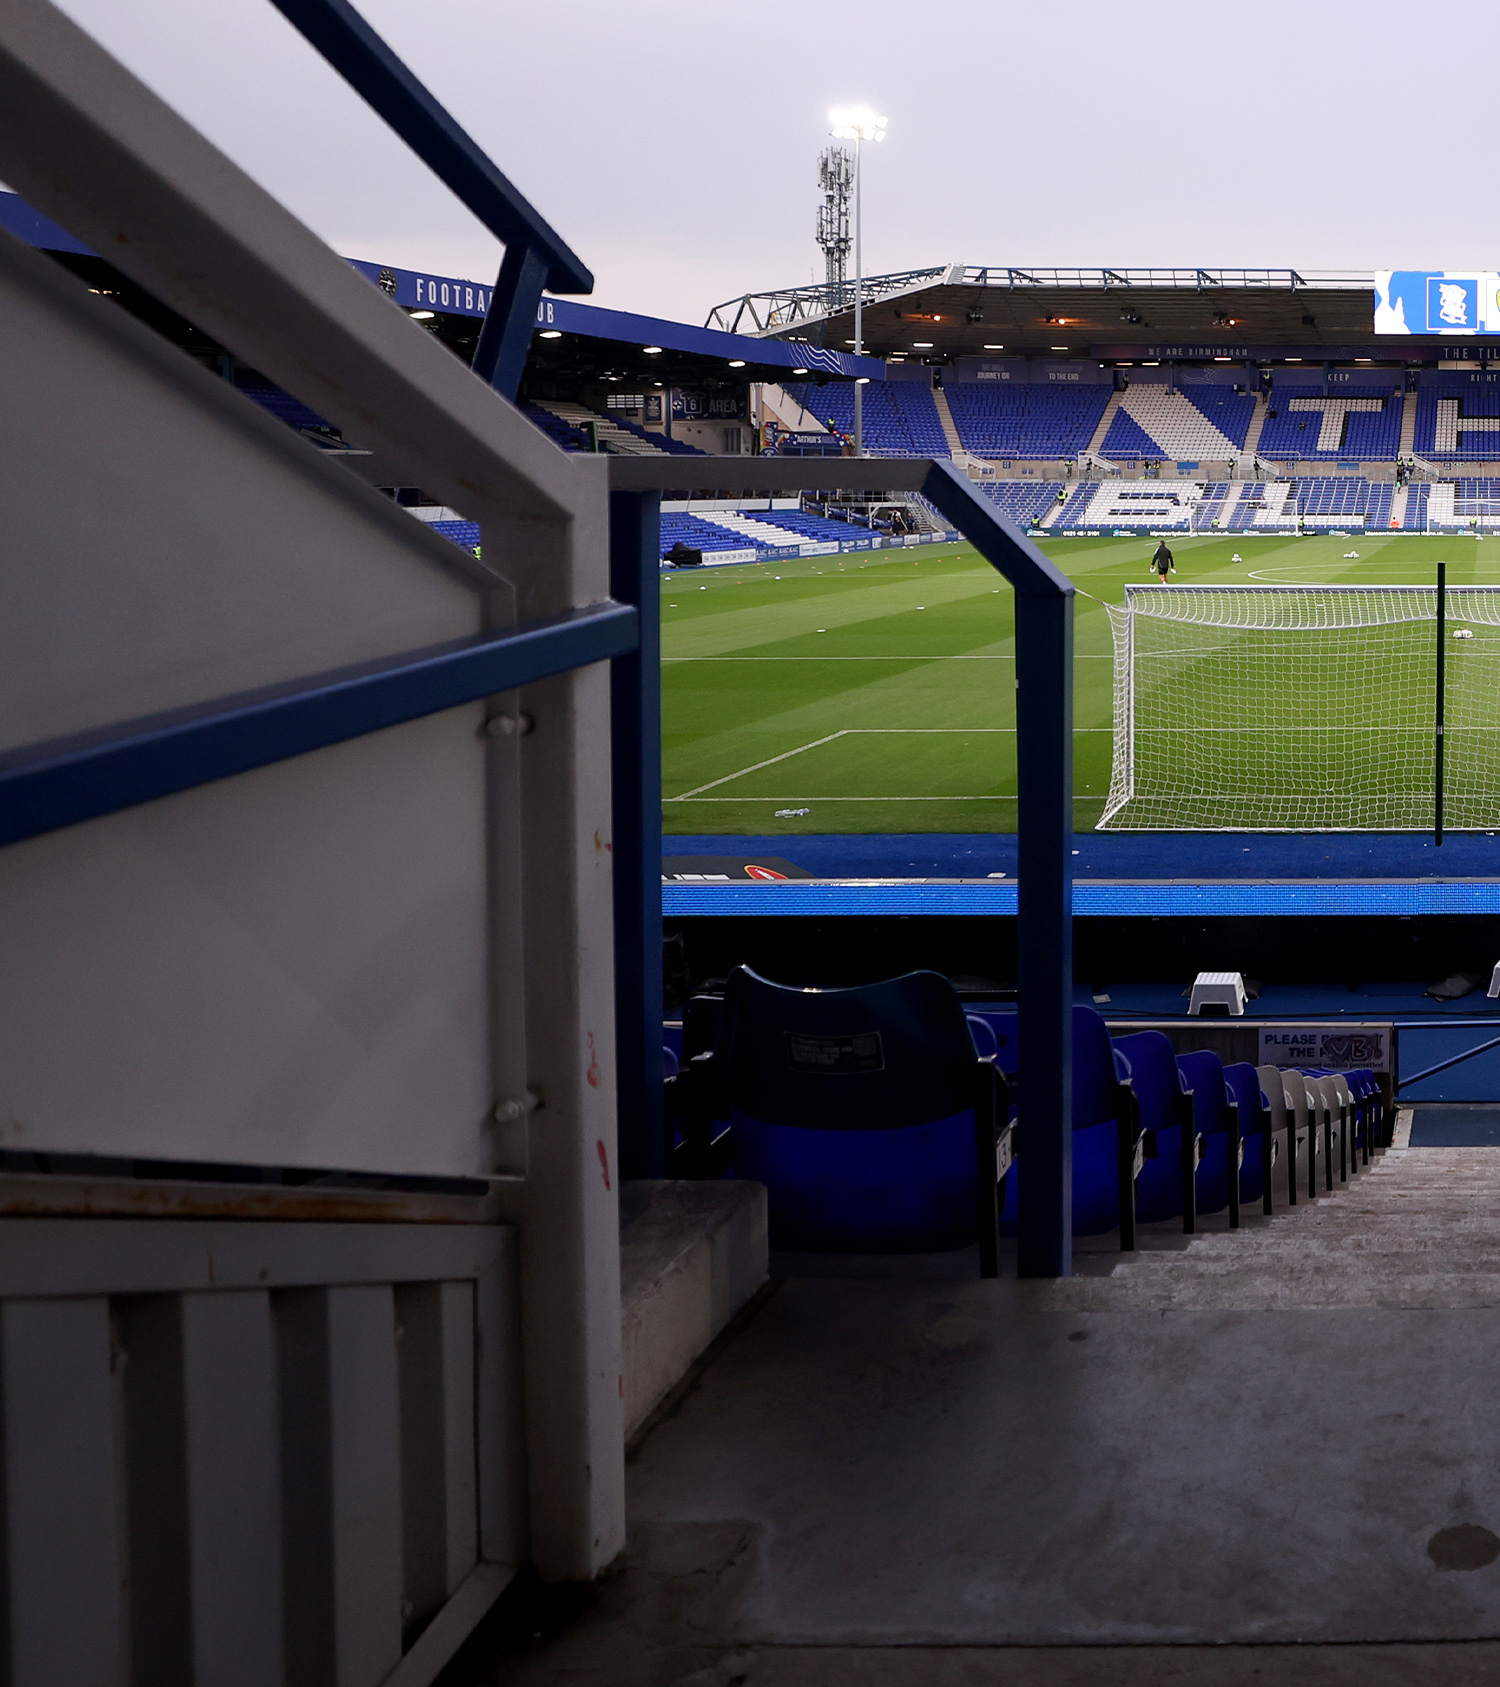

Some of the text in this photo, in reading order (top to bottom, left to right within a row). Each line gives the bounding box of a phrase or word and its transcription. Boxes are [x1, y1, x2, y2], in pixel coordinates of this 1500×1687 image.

[416, 278, 493, 313] FOOTBA
[1148, 348, 1160, 356] WE
[1166, 348, 1183, 356] ARE
[1443, 348, 1468, 360] THE
[977, 372, 1001, 380] JOURNEY
[1327, 374, 1350, 382] KEEP
[1470, 374, 1498, 382] RIHT
[690, 399, 697, 411] 6
[709, 399, 738, 413] AREA
[1264, 1034, 1317, 1045] PLEASE
[1288, 1047, 1315, 1058] THE
